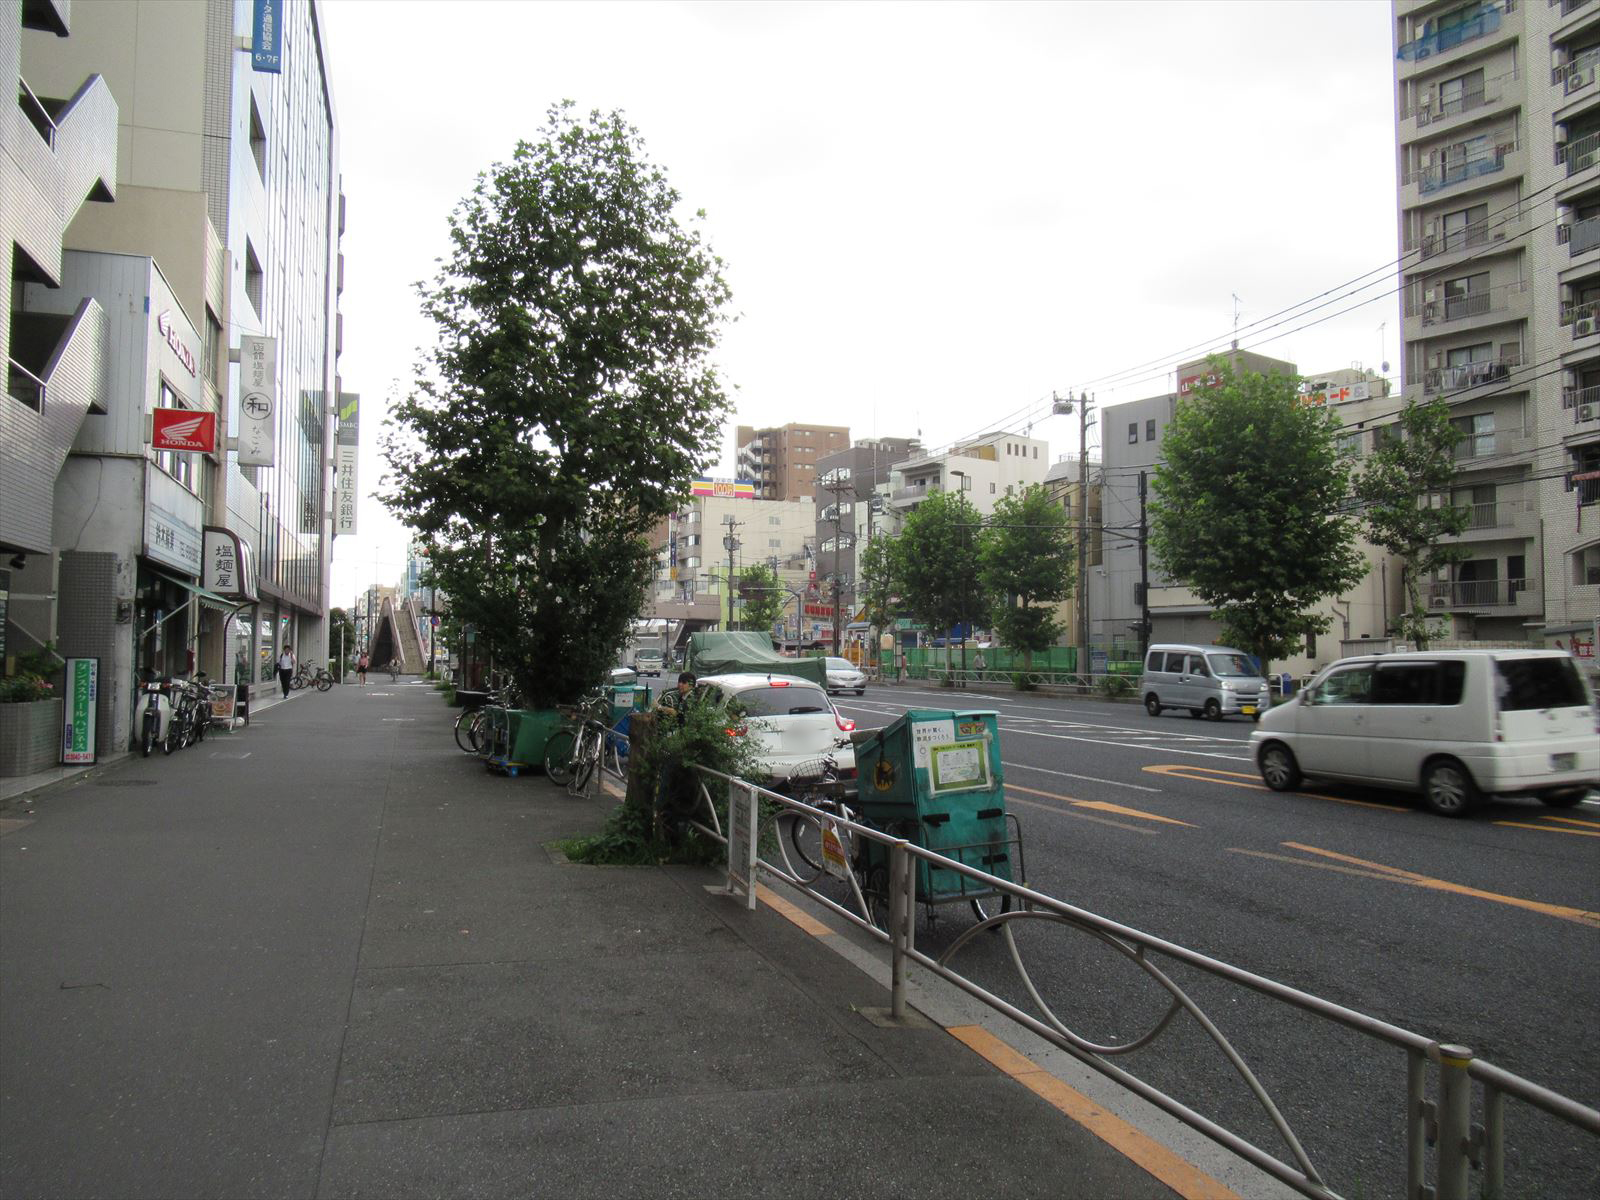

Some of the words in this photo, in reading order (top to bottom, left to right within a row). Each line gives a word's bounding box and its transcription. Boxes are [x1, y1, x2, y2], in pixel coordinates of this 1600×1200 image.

[246, 397, 269, 414] 和
[340, 420, 358, 429] SMBC
[160, 439, 204, 447] HONDA
[340, 450, 355, 530] 三井住友銀行
[215, 544, 234, 588] 塩麺屋
